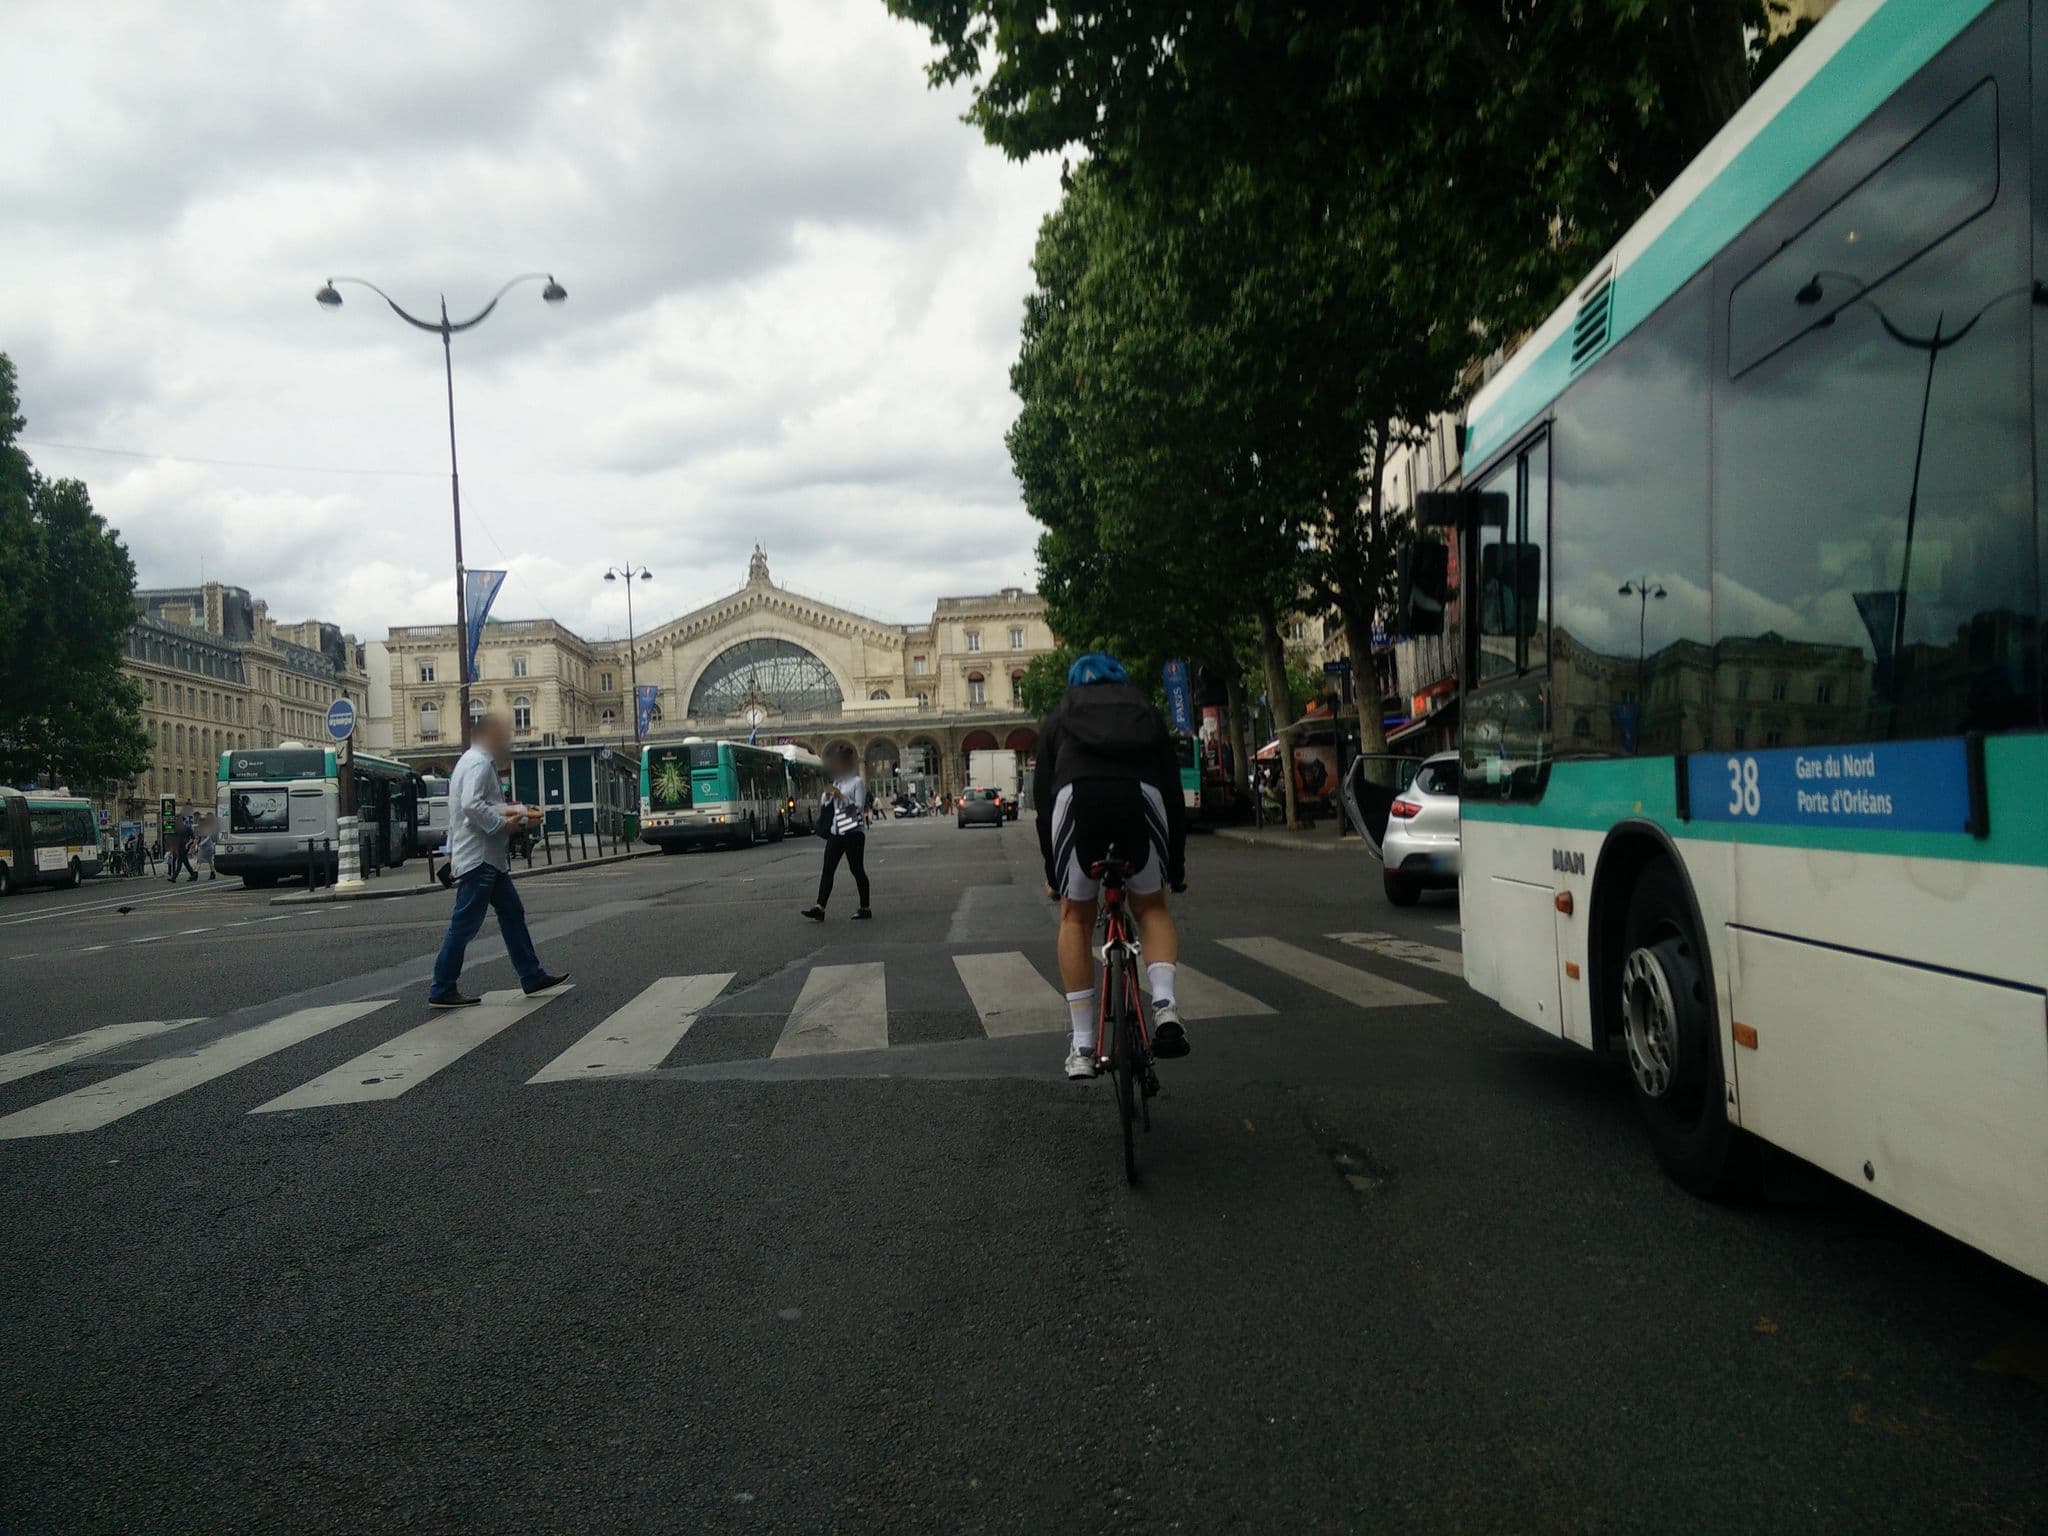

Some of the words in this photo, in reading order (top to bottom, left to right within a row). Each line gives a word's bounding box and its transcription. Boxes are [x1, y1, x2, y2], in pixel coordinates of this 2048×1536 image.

[1173, 687, 1185, 722] PARIS
[1796, 756, 1823, 779] Gare
[1826, 754, 1840, 778] du
[1842, 752, 1875, 777] Nord
[1727, 756, 1761, 816] 38
[1797, 790, 1829, 813] Porte
[1831, 789, 1893, 815] d'Orléans
[1552, 848, 1585, 876] MAN
